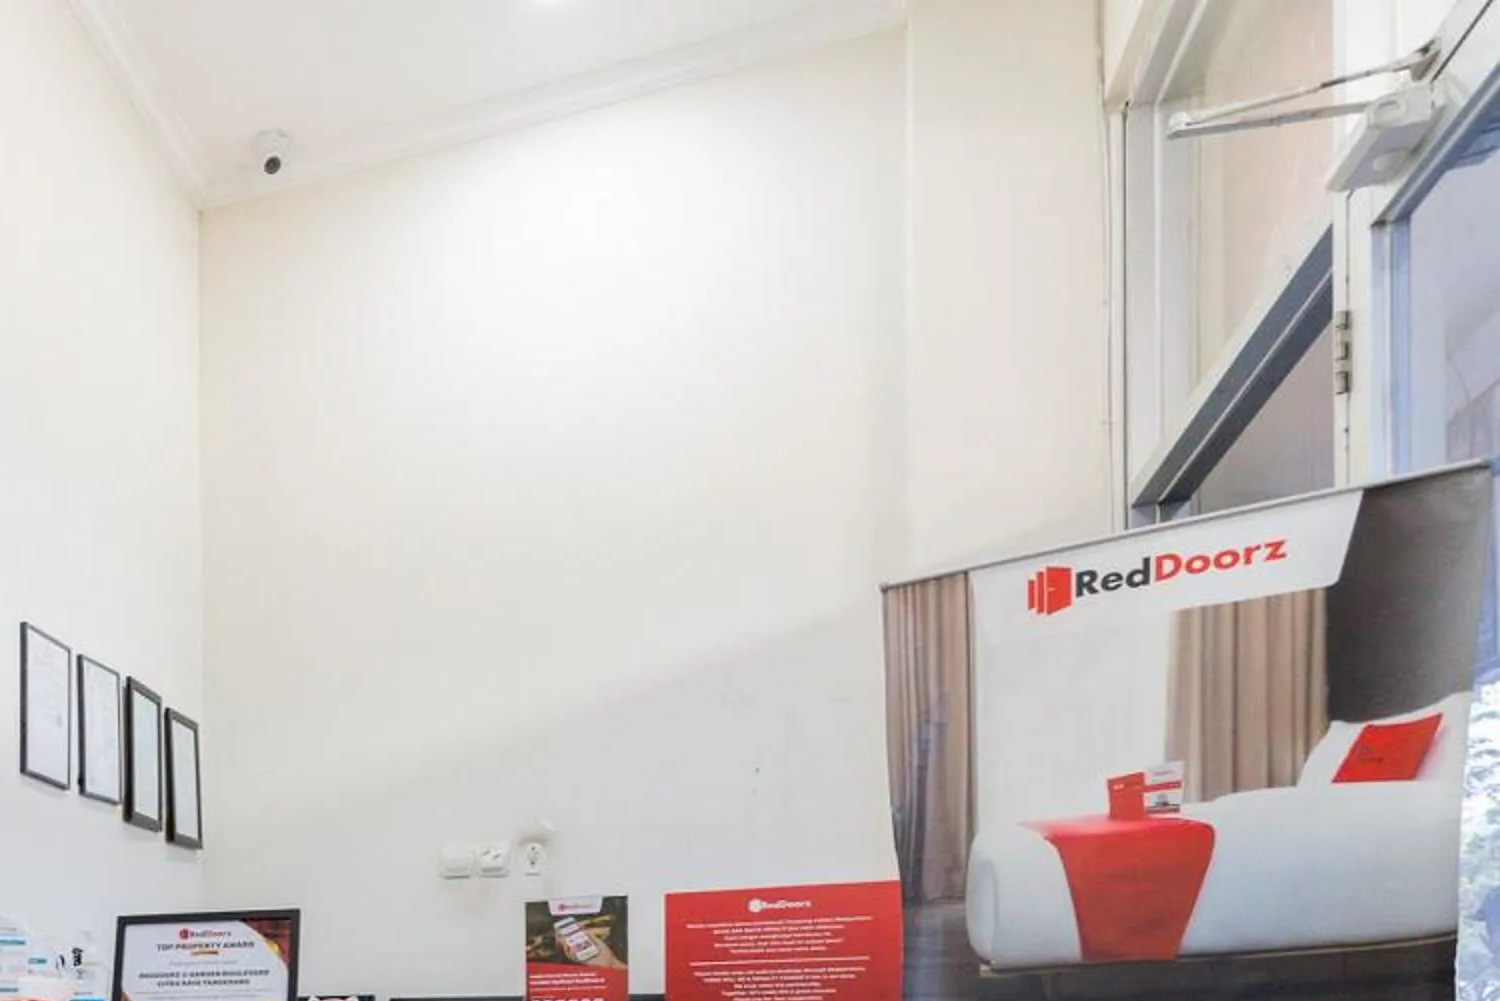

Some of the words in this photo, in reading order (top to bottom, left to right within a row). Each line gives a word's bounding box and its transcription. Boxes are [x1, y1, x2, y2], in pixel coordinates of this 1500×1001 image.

[1075, 540, 1287, 597] RedDoorz
[156, 943, 173, 952] TOP
[175, 942, 221, 951] PROPERTY
[223, 940, 255, 949] AWARD
